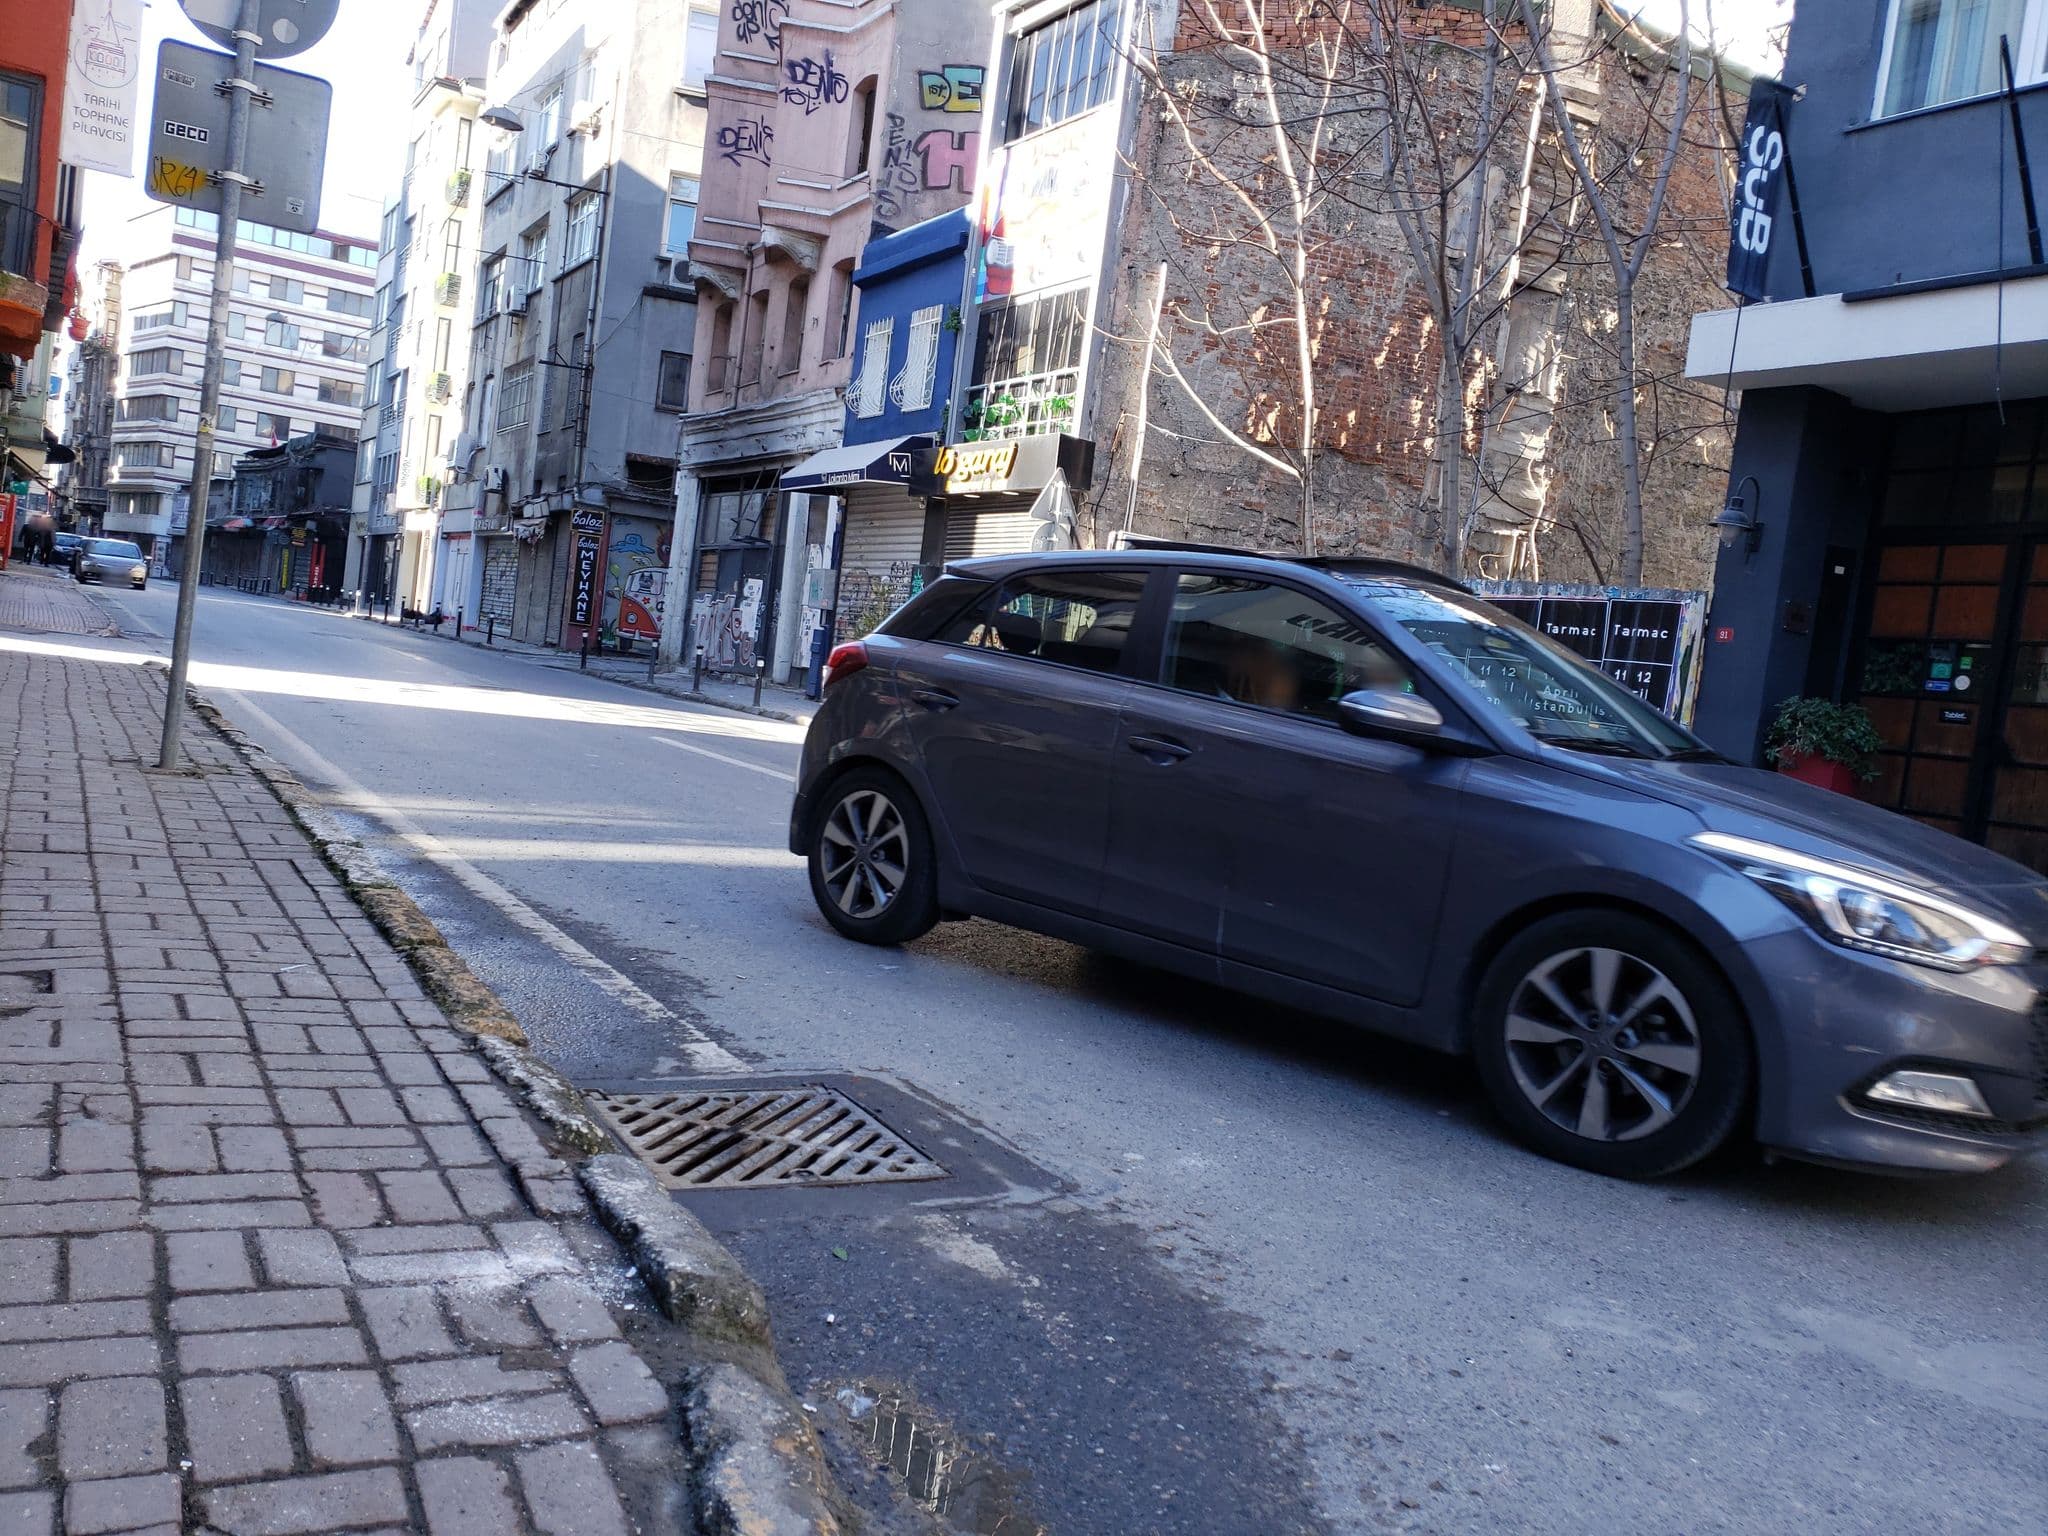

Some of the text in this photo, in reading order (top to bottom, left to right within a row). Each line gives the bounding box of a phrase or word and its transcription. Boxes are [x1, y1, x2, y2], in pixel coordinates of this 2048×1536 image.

[73, 105, 129, 129] TOPHANE
[576, 550, 594, 621] MEYHANE
[1546, 623, 1597, 636] Tarmac
[1614, 624, 1669, 639] Tarmac
[1637, 671, 1652, 683] 12
